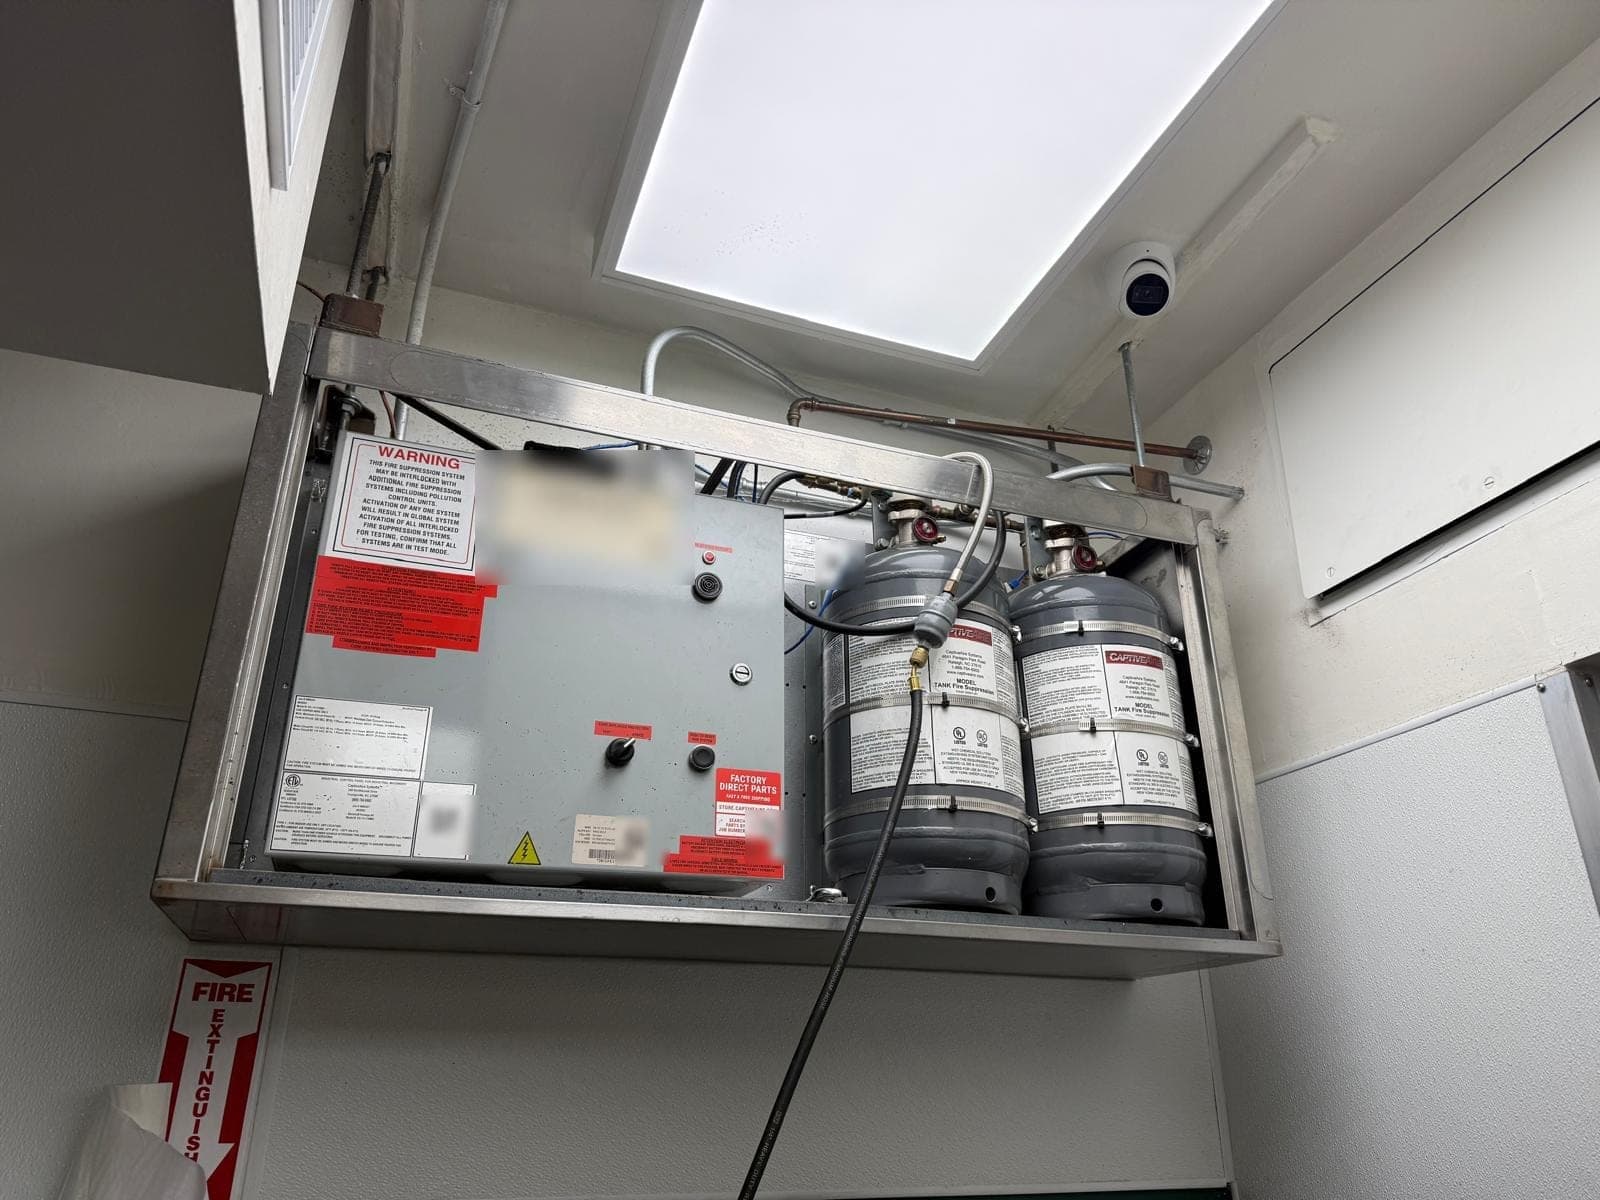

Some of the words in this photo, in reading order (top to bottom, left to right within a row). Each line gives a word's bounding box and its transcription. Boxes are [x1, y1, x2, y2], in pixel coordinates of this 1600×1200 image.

[378, 445, 460, 470] WARNING
[369, 459, 383, 467] THIS
[399, 464, 440, 477] SUPPRESSION
[441, 471, 465, 480] SYSTEM
[399, 472, 440, 484] INTERLOCKED
[441, 479, 457, 487] WITH
[365, 482, 394, 492] SYSTEMS
[395, 488, 428, 498] INCLUDING
[429, 493, 462, 503] POLLUTION
[368, 475, 404, 487] ADDITIONAL
[405, 481, 418, 489] FIRE
[420, 483, 462, 496] SUPPRESSION
[362, 498, 398, 508] ACTIVATION
[408, 504, 421, 512] ANY
[422, 507, 435, 515] ONE
[436, 509, 460, 518] SYSTEM
[388, 494, 416, 504] CONTROL
[418, 499, 437, 507] UNITS.
[358, 513, 395, 524] ACTIVATION
[418, 522, 459, 533] INTERLOCKED
[361, 505, 376, 513] WILL
[378, 508, 402, 517] RESULT
[410, 513, 434, 522] GLOBAL
[435, 517, 459, 526] SYSTEM
[356, 528, 369, 536] FOR
[399, 535, 428, 545] CONFIRM
[445, 541, 457, 549] ALL
[363, 521, 376, 529] FIRE
[378, 524, 421, 535] SUPPRESSION
[422, 530, 451, 540] SYSTEMS.
[361, 537, 390, 547] SYSTEMS
[414, 545, 429, 553] TEST
[429, 547, 450, 556] MODE.
[956, 678, 977, 686] MODEL
[965, 683, 995, 695] Suppression
[719, 782, 749, 792] DIRECT
[750, 785, 777, 795] PARTS
[730, 774, 767, 785] FACTORY
[191, 982, 256, 1003] FIRE
